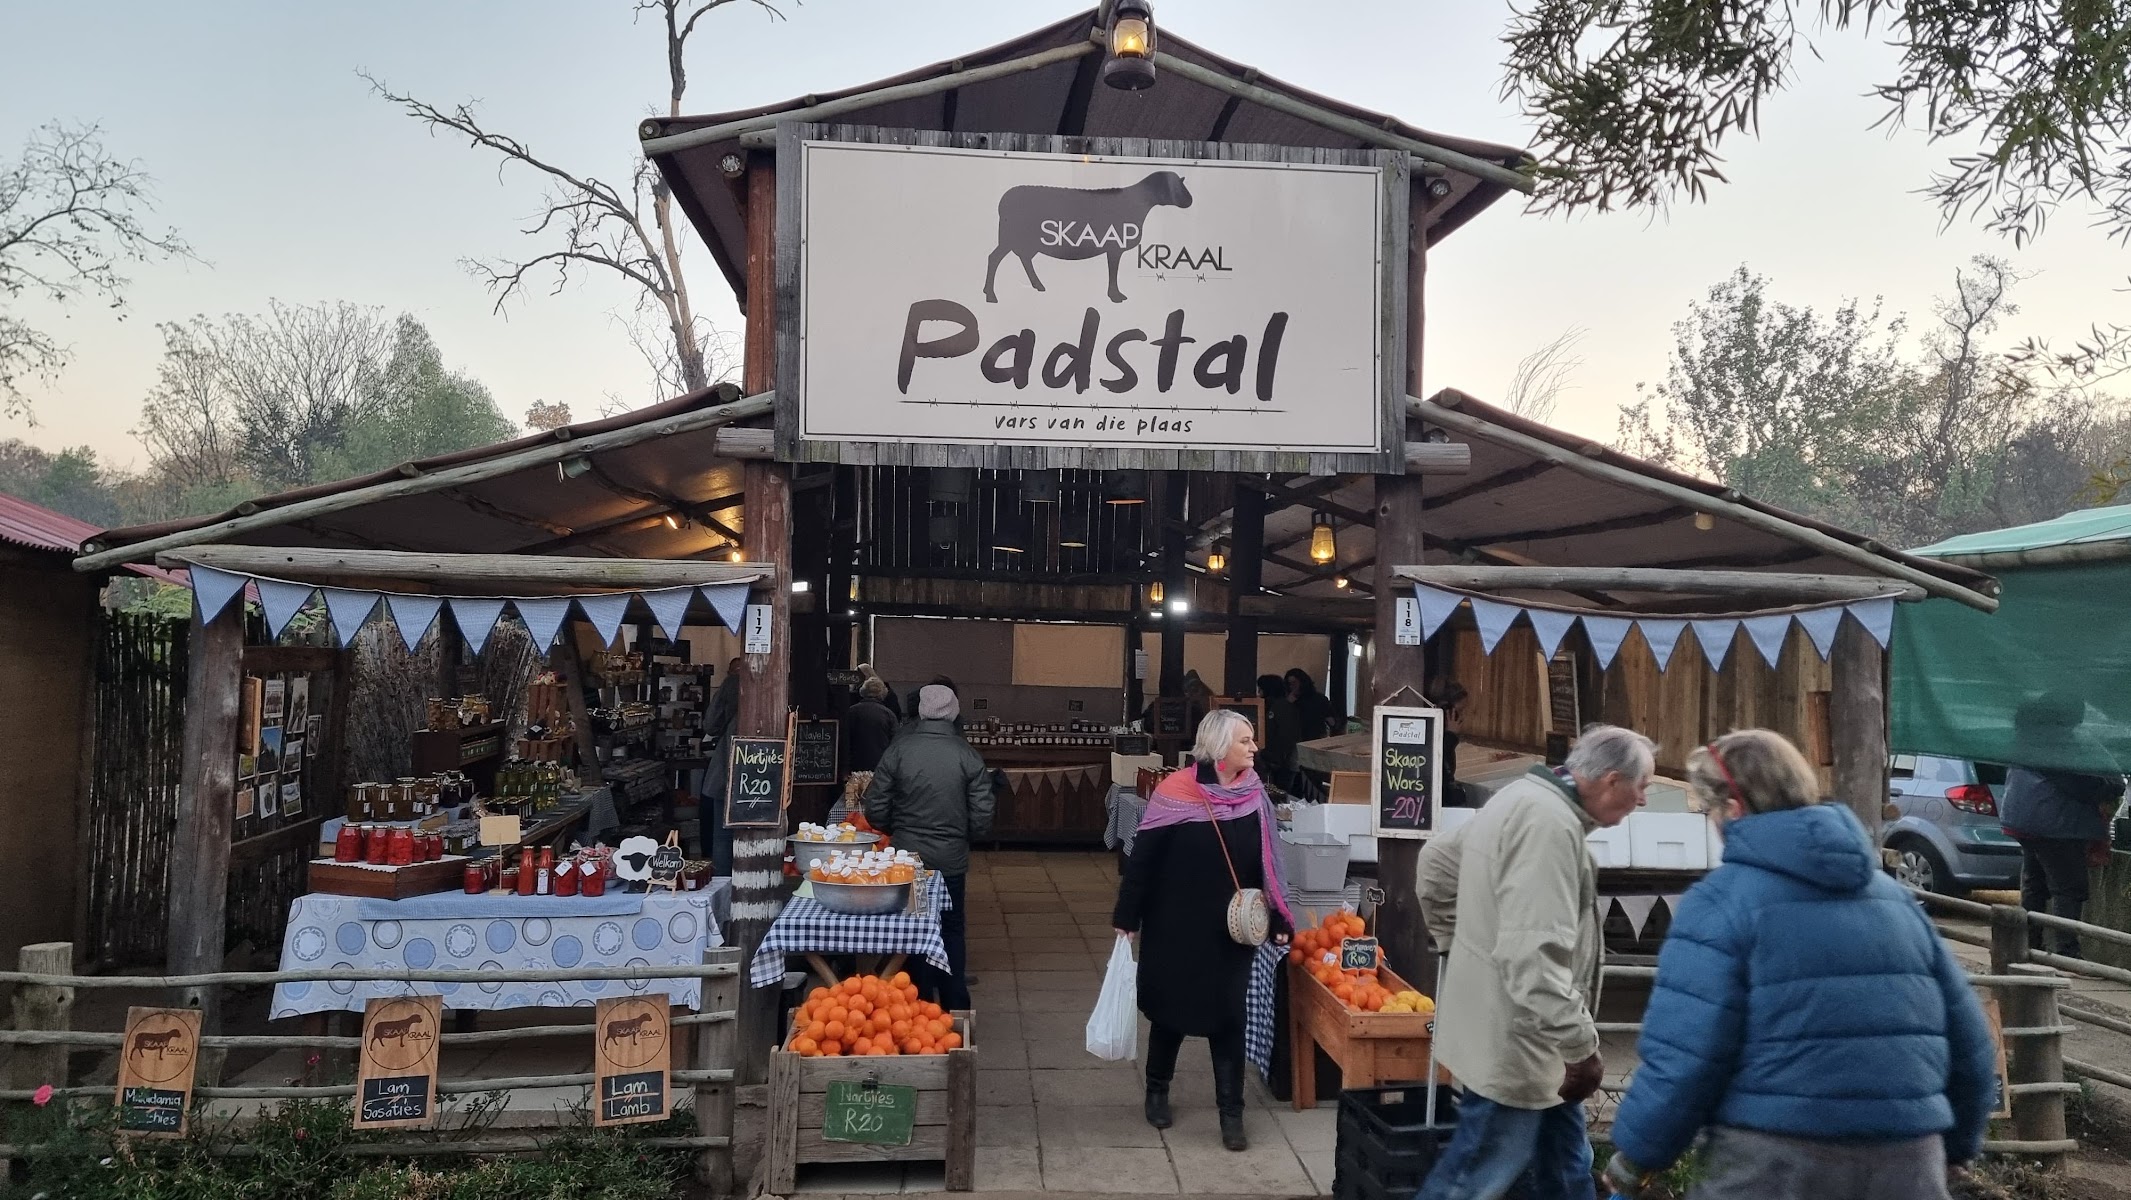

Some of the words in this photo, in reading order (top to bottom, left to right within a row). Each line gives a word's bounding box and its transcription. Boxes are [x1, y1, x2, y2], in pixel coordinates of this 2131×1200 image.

[1040, 219, 1140, 249] SKAAP
[1138, 244, 1233, 272] KRAAL
[898, 298, 1289, 402] Padstal
[994, 414, 1037, 430] vars
[1046, 416, 1086, 432] van
[1095, 414, 1127, 433] die
[1135, 415, 1194, 436] plaas
[799, 725, 831, 740] Navels
[1392, 730, 1421, 739] Padstal
[1385, 747, 1427, 779] Skaap
[740, 772, 772, 796] R20
[1386, 768, 1425, 792] Wors
[1383, 795, 1426, 826] -20%
[652, 853, 682, 869] Welkom
[378, 1079, 410, 1095] Lam
[612, 1076, 648, 1097] Lam
[840, 1083, 895, 1110] Nartjies
[610, 1096, 651, 1118] Lamb
[845, 1107, 884, 1135] R20
